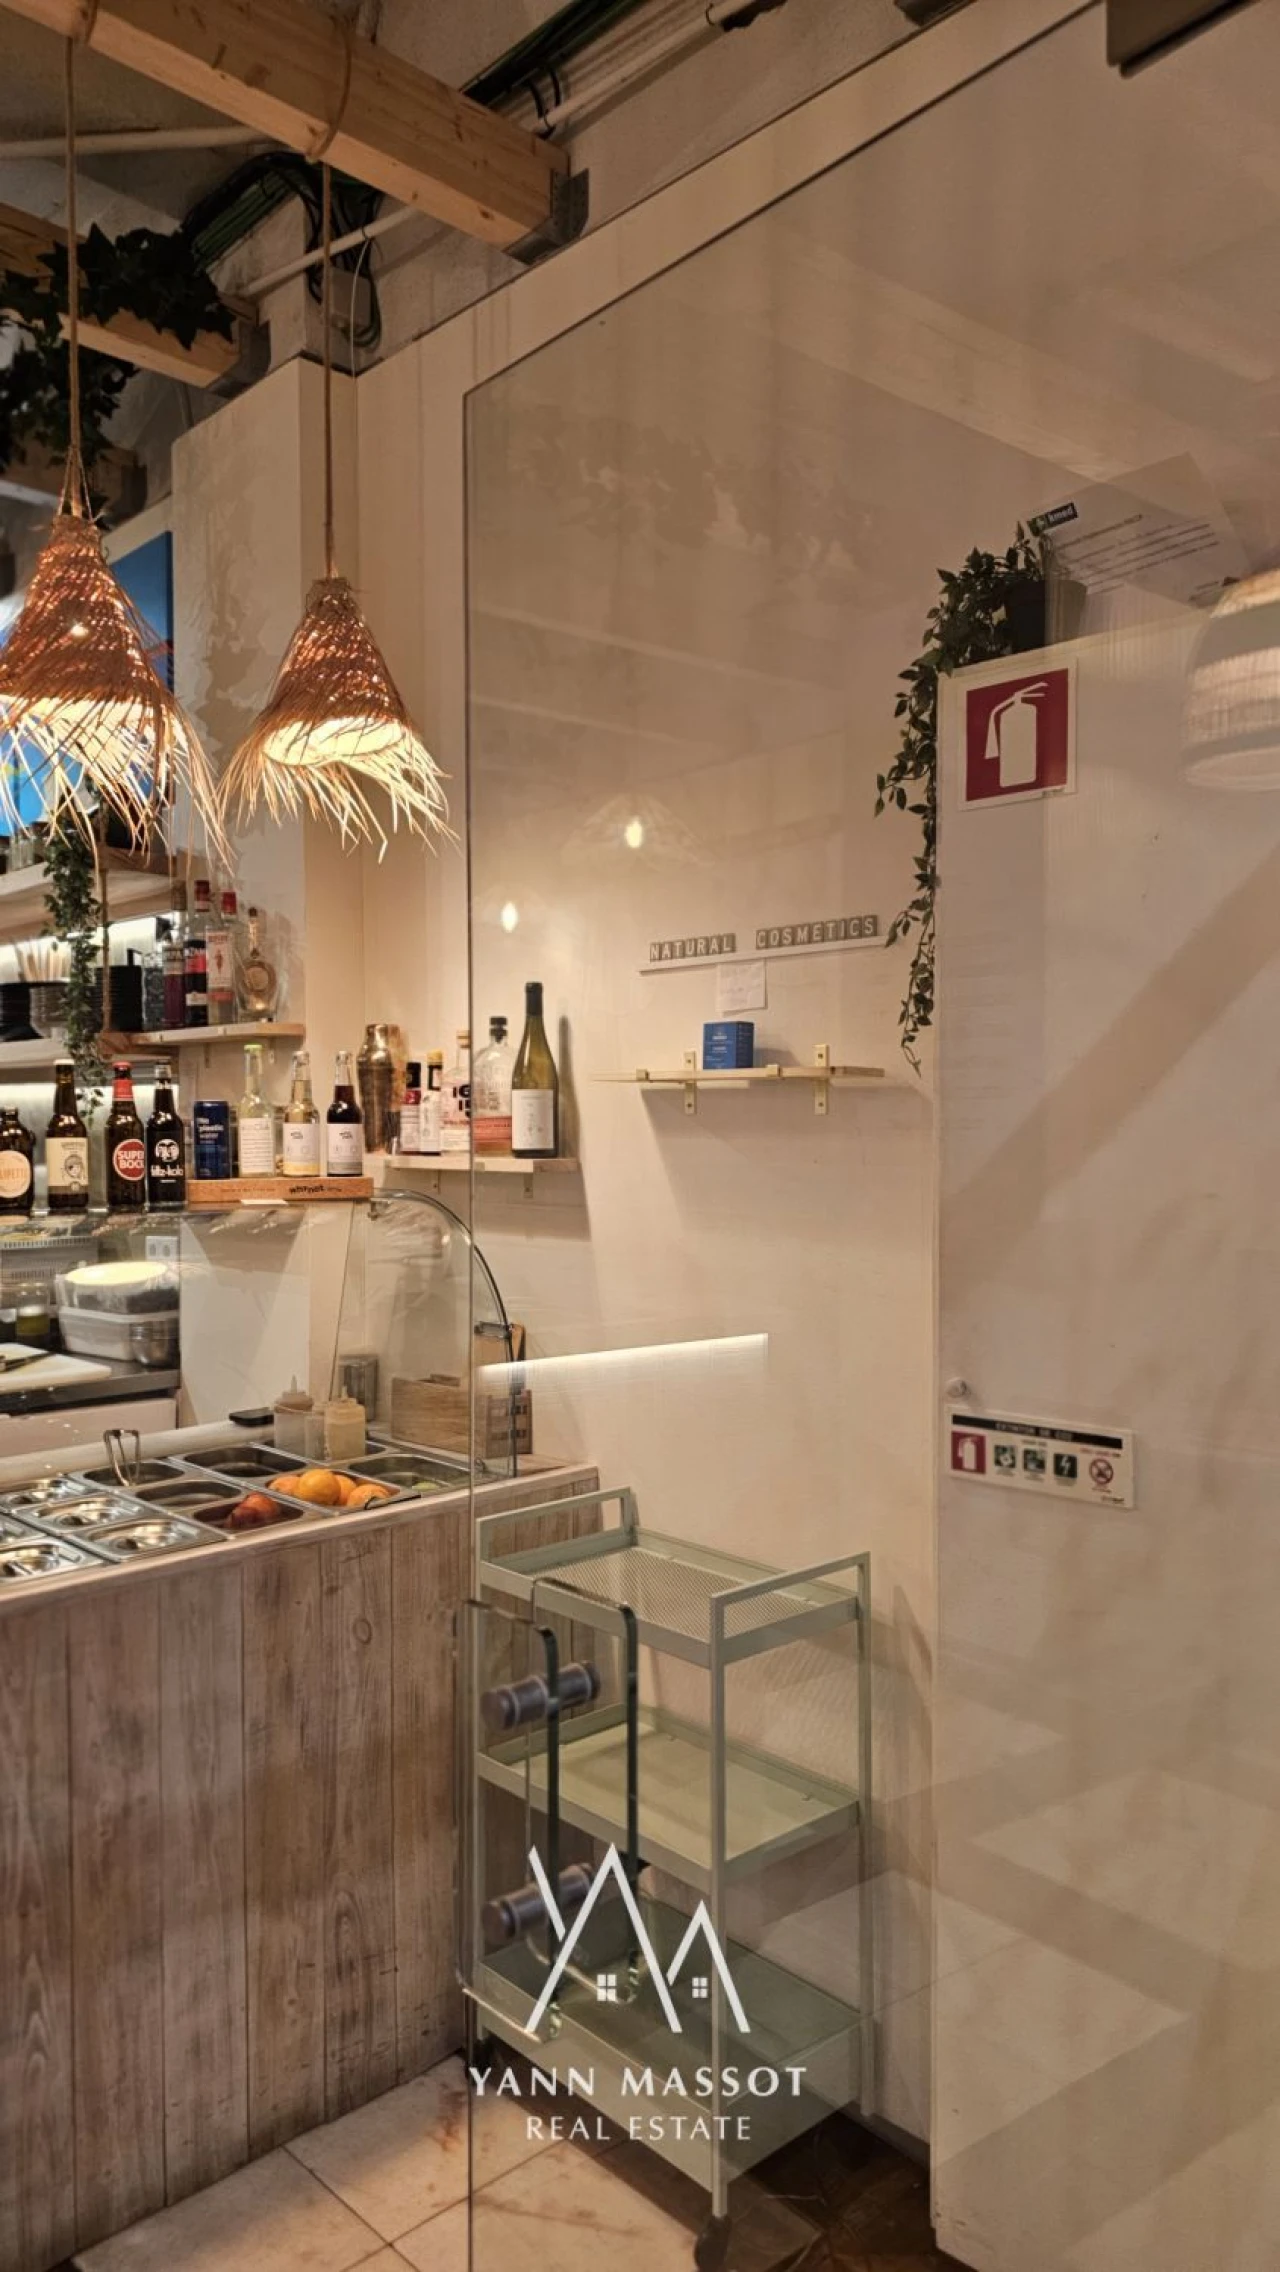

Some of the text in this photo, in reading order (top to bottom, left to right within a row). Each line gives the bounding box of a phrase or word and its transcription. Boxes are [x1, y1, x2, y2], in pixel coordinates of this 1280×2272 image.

[651, 916, 875, 960] NATURAL COSMETICS
[117, 1150, 145, 1160] SUPE
